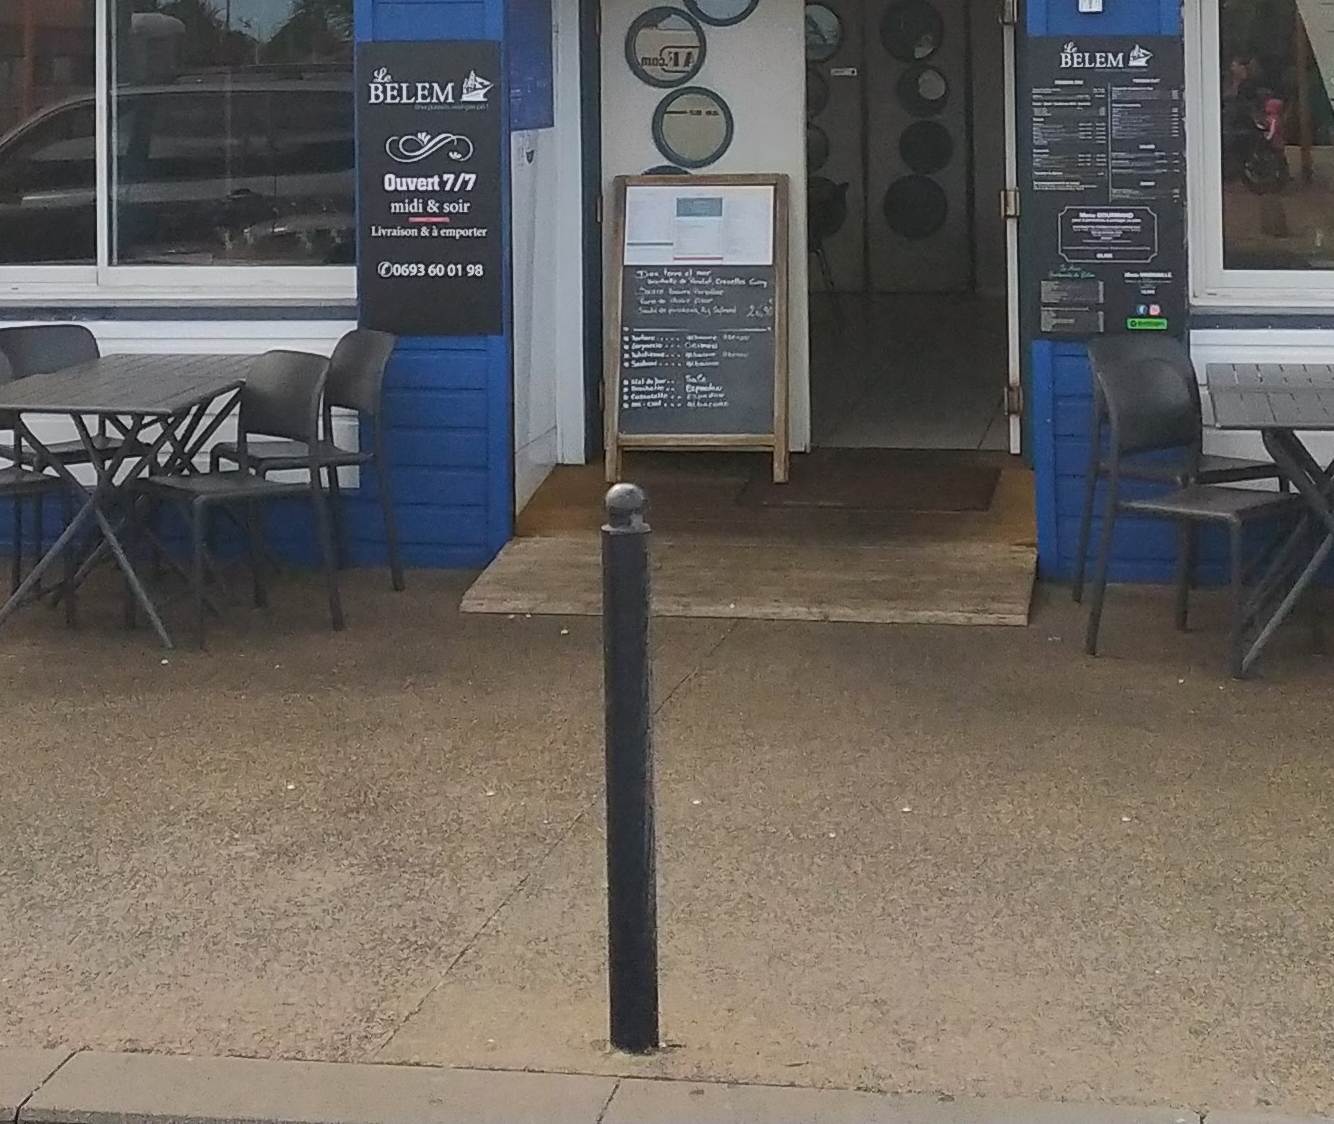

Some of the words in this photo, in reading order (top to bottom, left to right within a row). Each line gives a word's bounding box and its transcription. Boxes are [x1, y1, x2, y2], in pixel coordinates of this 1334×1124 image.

[1063, 41, 1078, 54] Le
[1059, 52, 1125, 68] BELEM
[372, 66, 393, 83] Le
[368, 82, 455, 104] BELEM
[383, 173, 441, 191] Ouvert
[442, 172, 477, 192] 7/7
[390, 198, 424, 213] midi
[426, 199, 440, 213] &
[442, 199, 471, 213] soir
[370, 226, 419, 237] Livraison
[420, 226, 430, 236] &
[431, 225, 439, 236] à
[439, 227, 488, 240] emporter
[392, 263, 426, 277] 0693
[427, 263, 446, 277] 60
[446, 263, 463, 277] 01
[465, 263, 485, 277] 98
